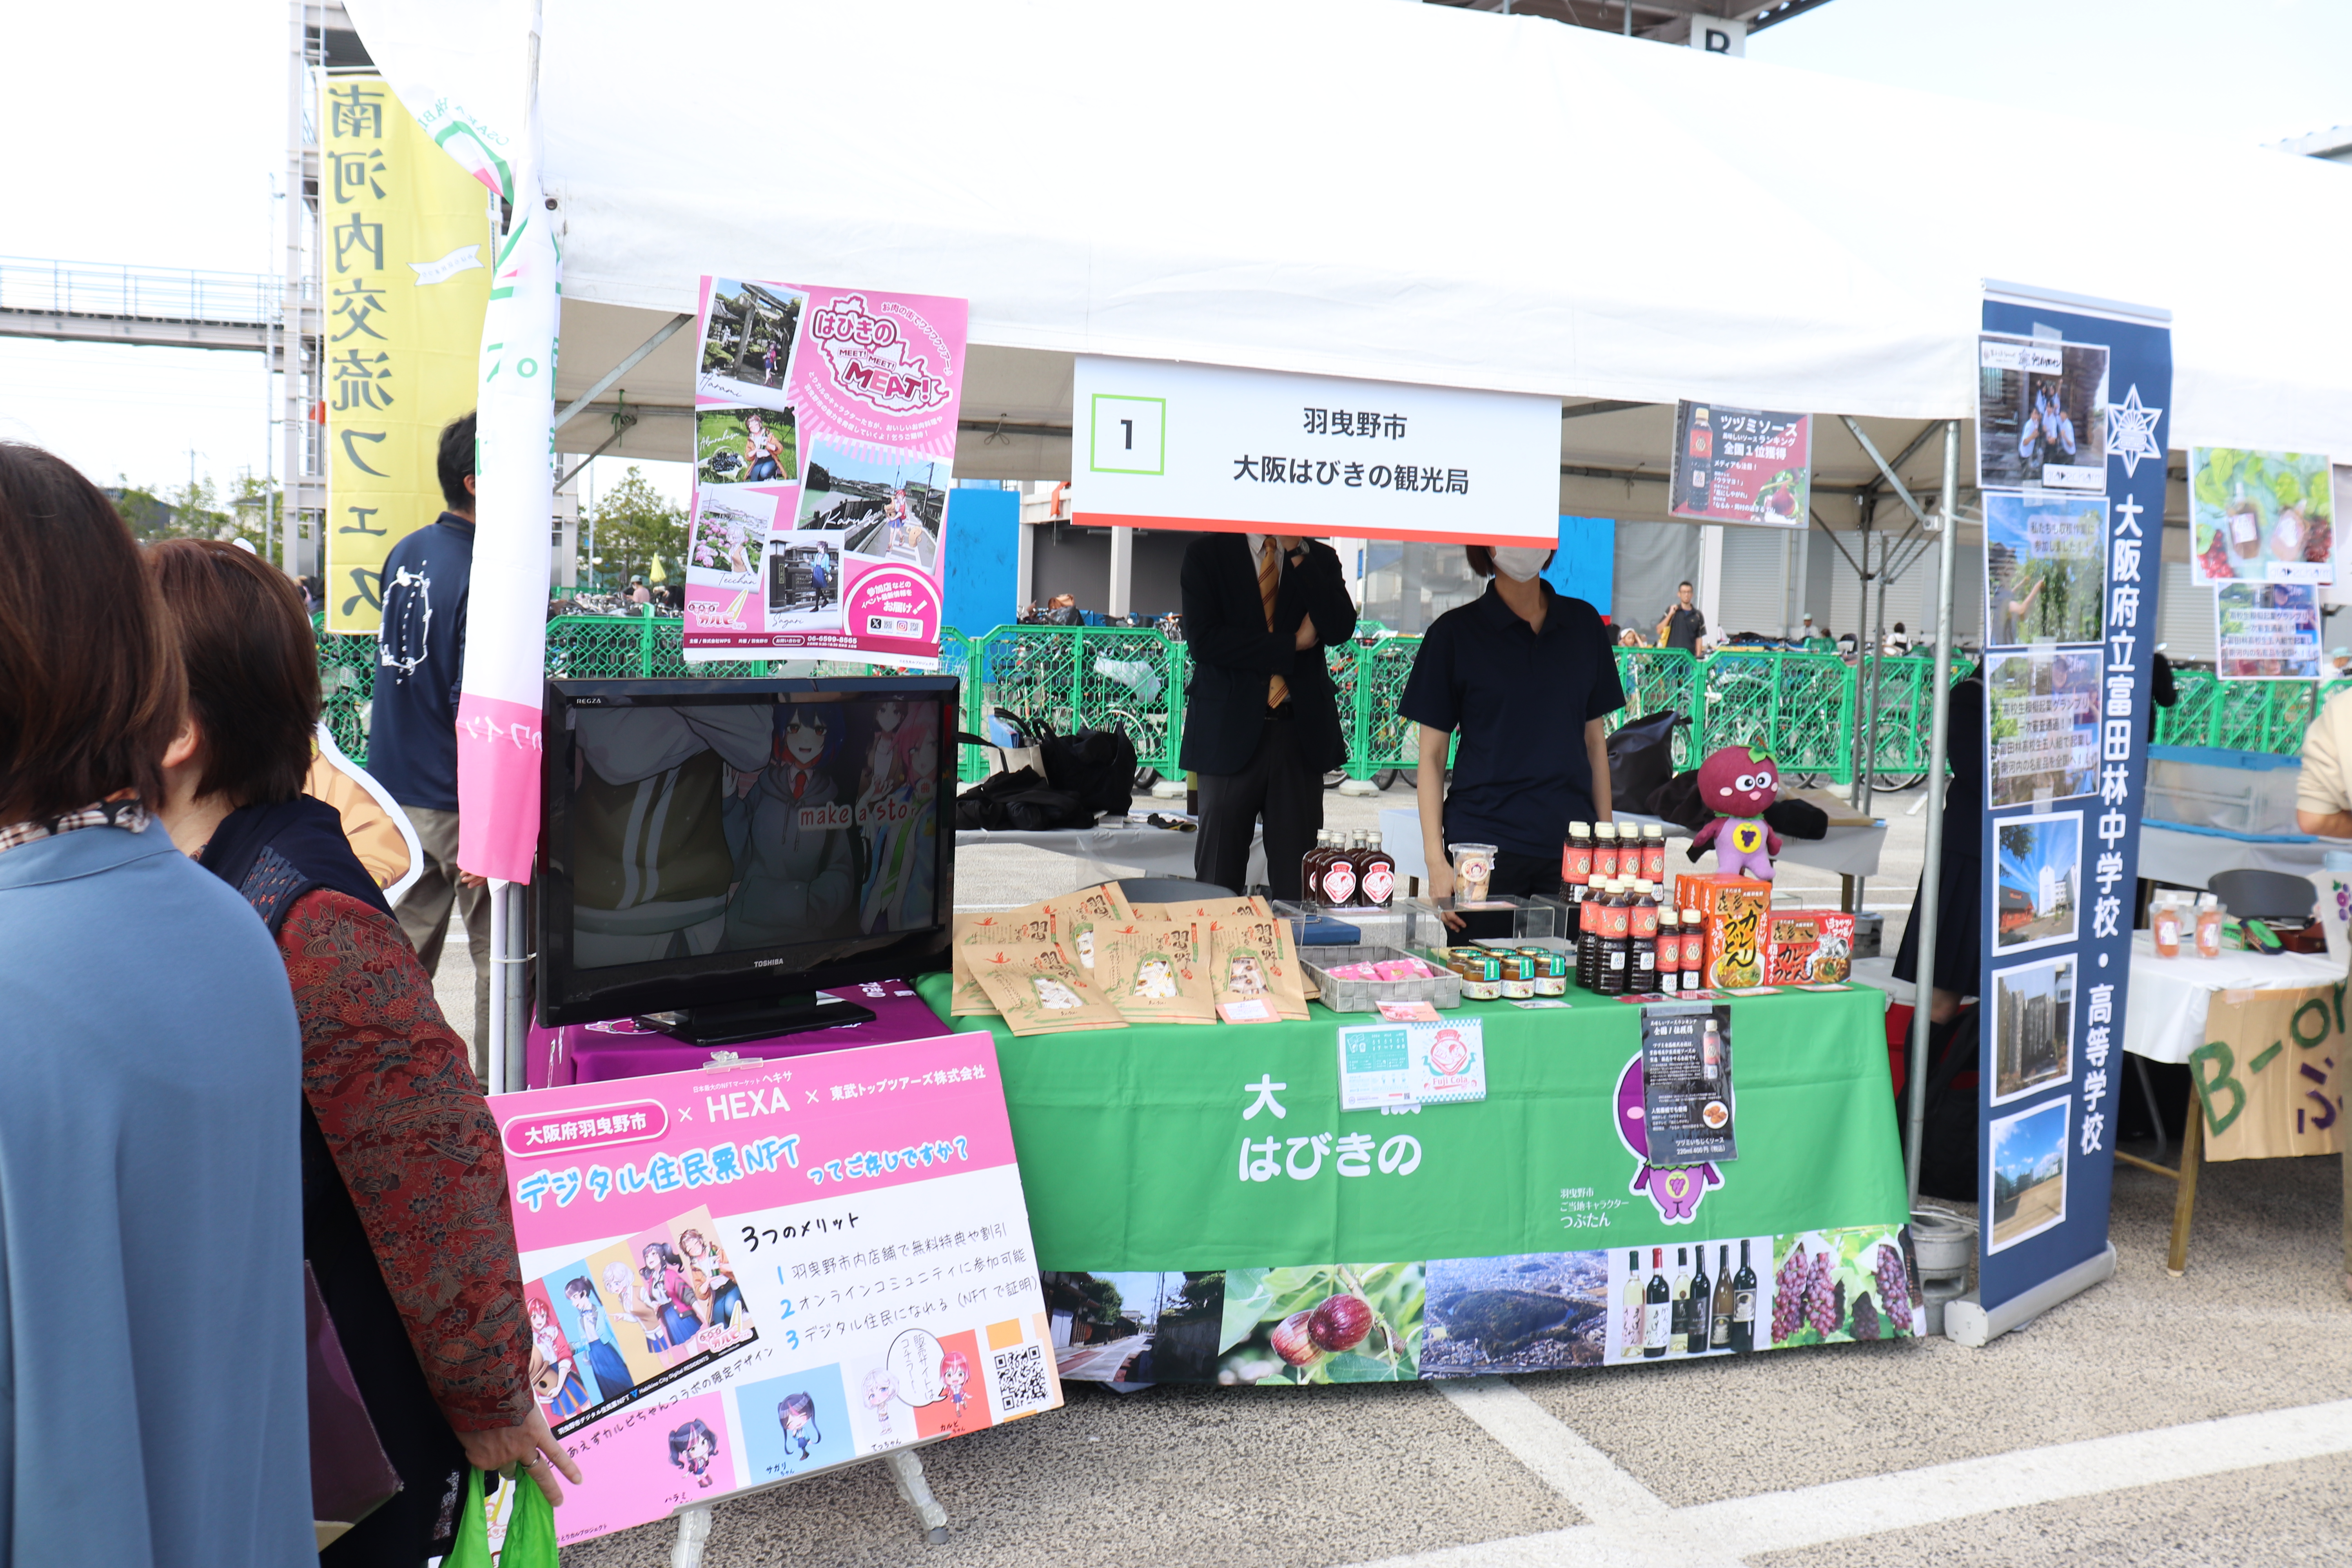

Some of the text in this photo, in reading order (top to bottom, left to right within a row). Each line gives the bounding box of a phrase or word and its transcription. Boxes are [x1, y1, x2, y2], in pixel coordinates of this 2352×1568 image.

[818, 313, 893, 343] はびきの
[839, 349, 867, 358] MEET!
[868, 356, 896, 370] MEET!
[700, 372, 742, 397] Harami
[845, 361, 931, 401] MEAT!
[1120, 419, 1134, 451] 1
[1303, 407, 1408, 441] 羽曳野市
[1720, 415, 1798, 437] ツヅミソース
[1232, 453, 1470, 496] 大阪はびきの観光局
[820, 508, 879, 530] Karubi
[719, 572, 757, 586] Tecchan
[772, 612, 804, 629] Sagari
[800, 805, 849, 826] make
[859, 808, 866, 821] a
[2080, 493, 2144, 1156] 大阪府立富田林中学校・高等学校
[753, 958, 784, 968] TOSHIBA
[693, 1070, 793, 1093] 日本最大のNFTマーケット ヘキサ
[1433, 1075, 1468, 1087] Fuji Cola
[524, 1112, 646, 1146] 大阪府羽曳野市
[706, 1086, 791, 1123] HEXA
[829, 1064, 987, 1102] 東武トップツアーズ株式会社
[808, 1136, 969, 1184] ってご存じですか？
[1239, 1131, 1422, 1183] はびきの
[1560, 1187, 1594, 1199] 羽曳野市
[1560, 1200, 1629, 1212] ご当地キャラクター
[742, 1212, 859, 1252] 3つのメリット
[1560, 1212, 1611, 1229] つぶたん
[791, 1221, 1007, 1281] 羽曳野市内店舗で無料特典や割引
[780, 1248, 1027, 1320] 2 オンラインコミュニティに参加可能
[786, 1330, 799, 1350] 3
[805, 1299, 948, 1342] デジタル住民になれる
[913, 1333, 935, 1401] 販売サイトは
[547, 1347, 774, 1468] あえずカルビちゃんコラボの限定デザイン
[766, 1462, 787, 1474] サガリ
[664, 1491, 686, 1503] ハラミ
